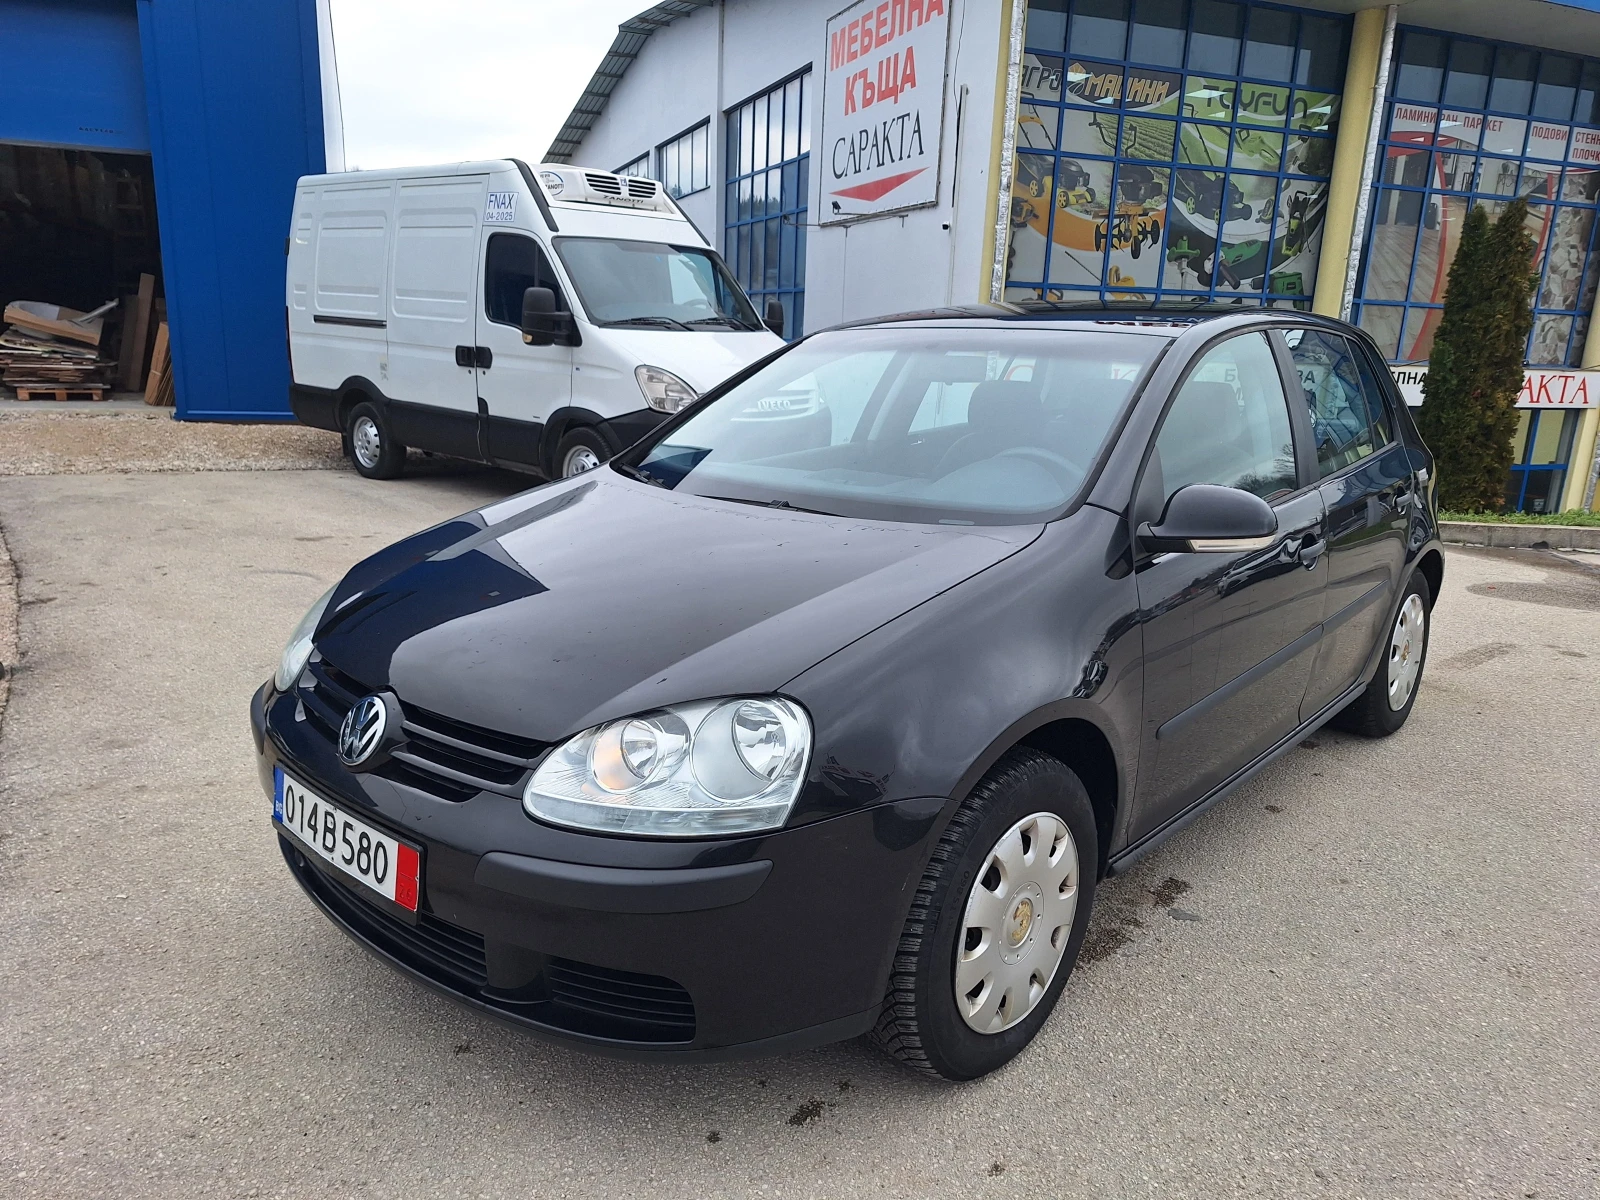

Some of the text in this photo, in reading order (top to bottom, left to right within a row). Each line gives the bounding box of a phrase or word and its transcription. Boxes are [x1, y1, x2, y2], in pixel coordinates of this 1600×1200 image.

[844, 45, 917, 116] КЪЩА
[1463, 116, 1504, 133] ПАРКЕТ
[1531, 125, 1568, 141] ПОДОВИ
[832, 109, 925, 180] САРАКТА
[487, 193, 515, 210] FNAX
[486, 211, 513, 221] 04-2025
[757, 400, 791, 411] IVECO
